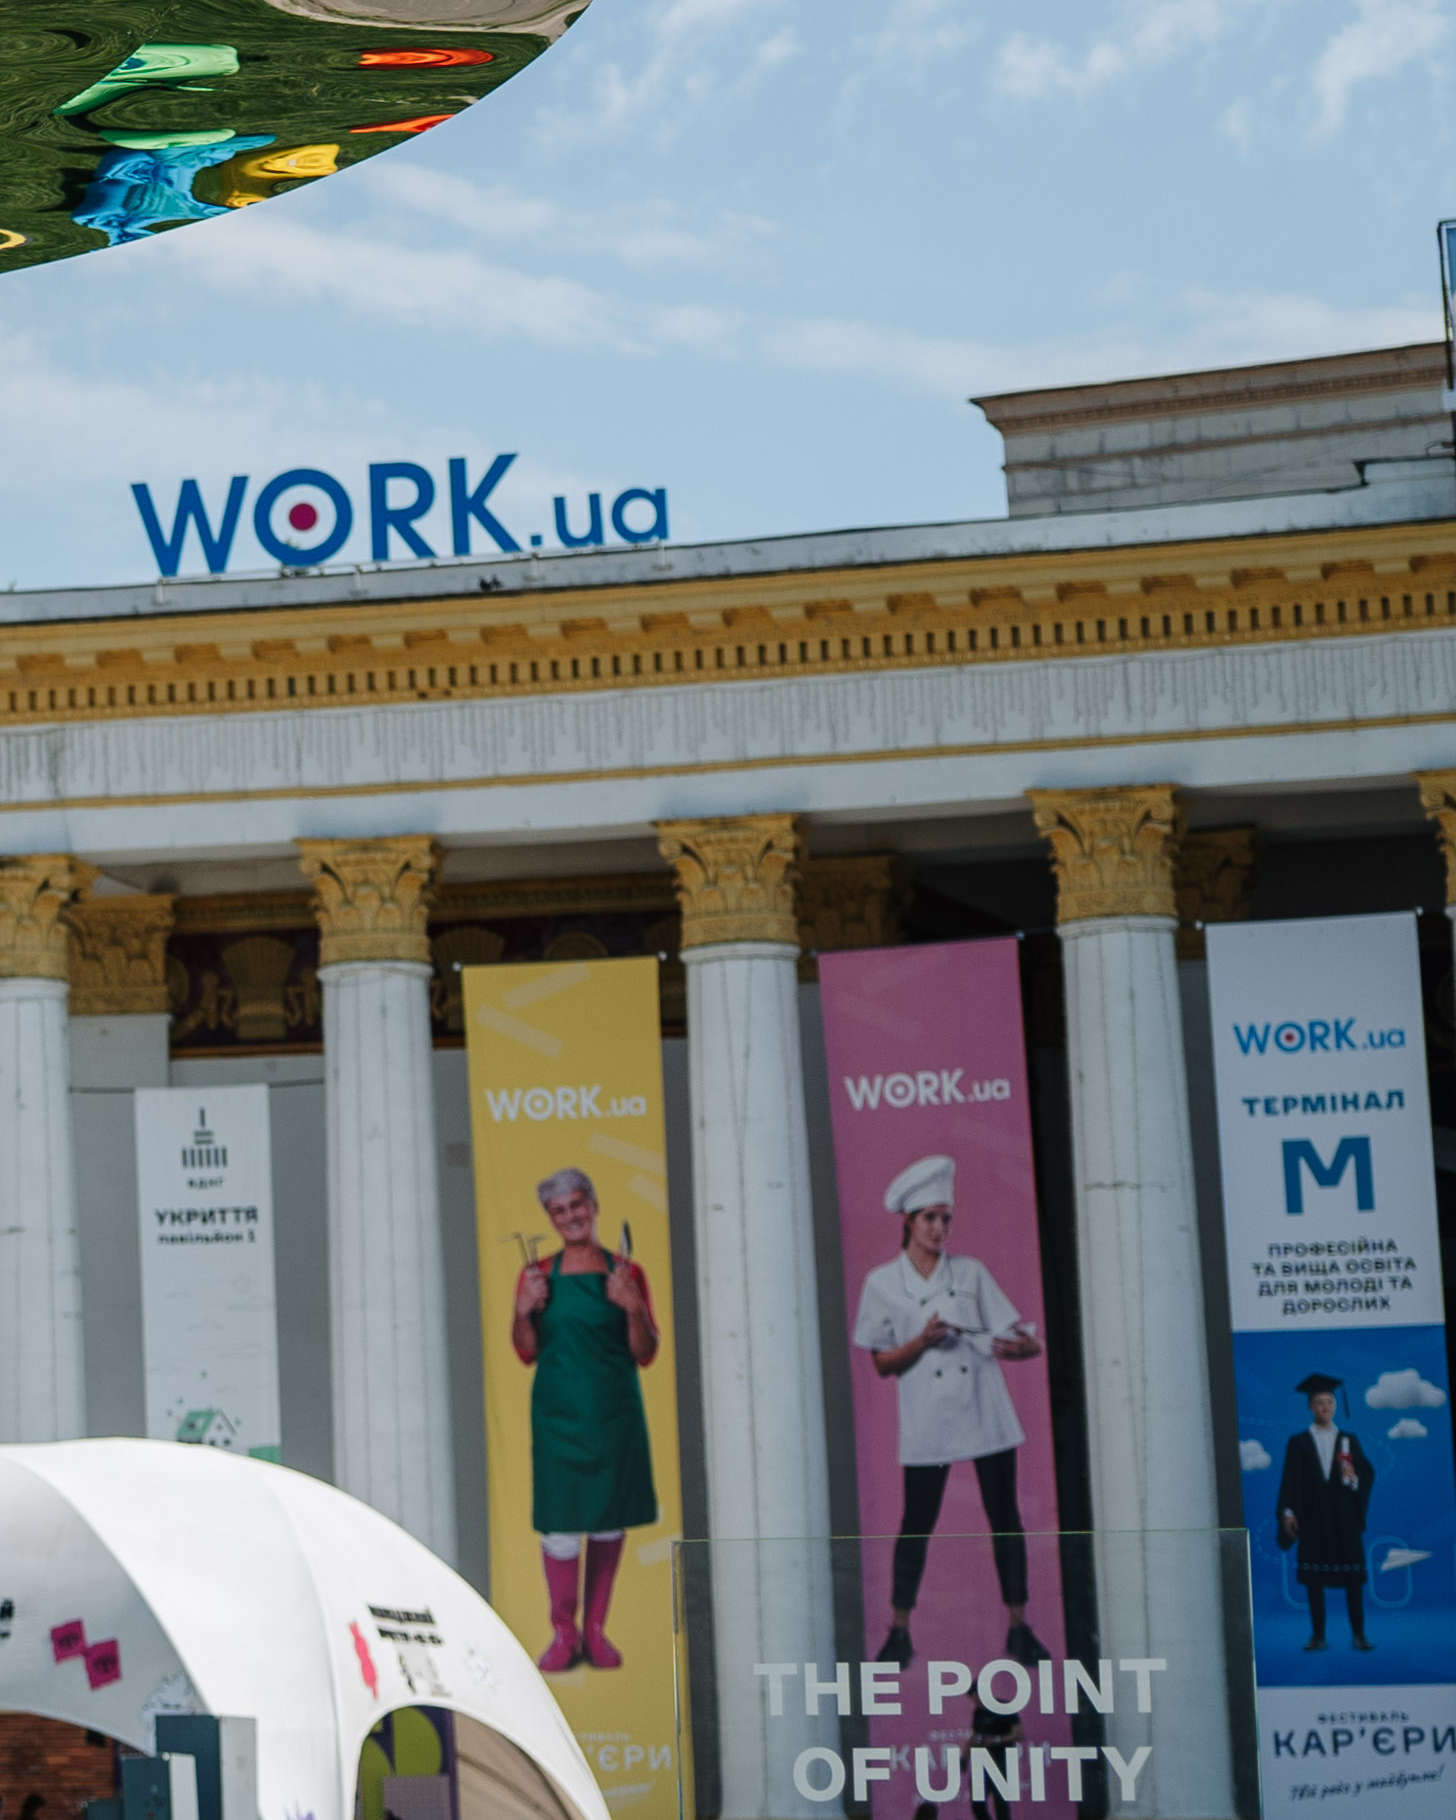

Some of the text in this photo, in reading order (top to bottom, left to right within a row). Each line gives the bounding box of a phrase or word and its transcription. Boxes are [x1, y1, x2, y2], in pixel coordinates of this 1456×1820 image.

[130, 452, 668, 577] WORK.ua
[1232, 1017, 1406, 1056] WORK.ua
[484, 1083, 647, 1123] WORK.ua
[843, 1067, 1012, 1112] WORK.ua
[1241, 1089, 1407, 1117] ТЕРМІНАЛ
[1281, 1135, 1377, 1215] М
[154, 1207, 259, 1226] УКРИТТЯ
[1251, 1256, 1418, 1277] ТА ВИЩА ОСВІТА
[1267, 1236, 1399, 1258] ПРОФЕСІЙНА
[1258, 1275, 1414, 1297] ДЛЯ МОЛОДІ ТА
[1281, 1296, 1392, 1316] ДОРОСЛИХ
[753, 1657, 1168, 1718] THE POINT
[792, 1746, 891, 1803] OF
[913, 1745, 1153, 1803] UNITY
